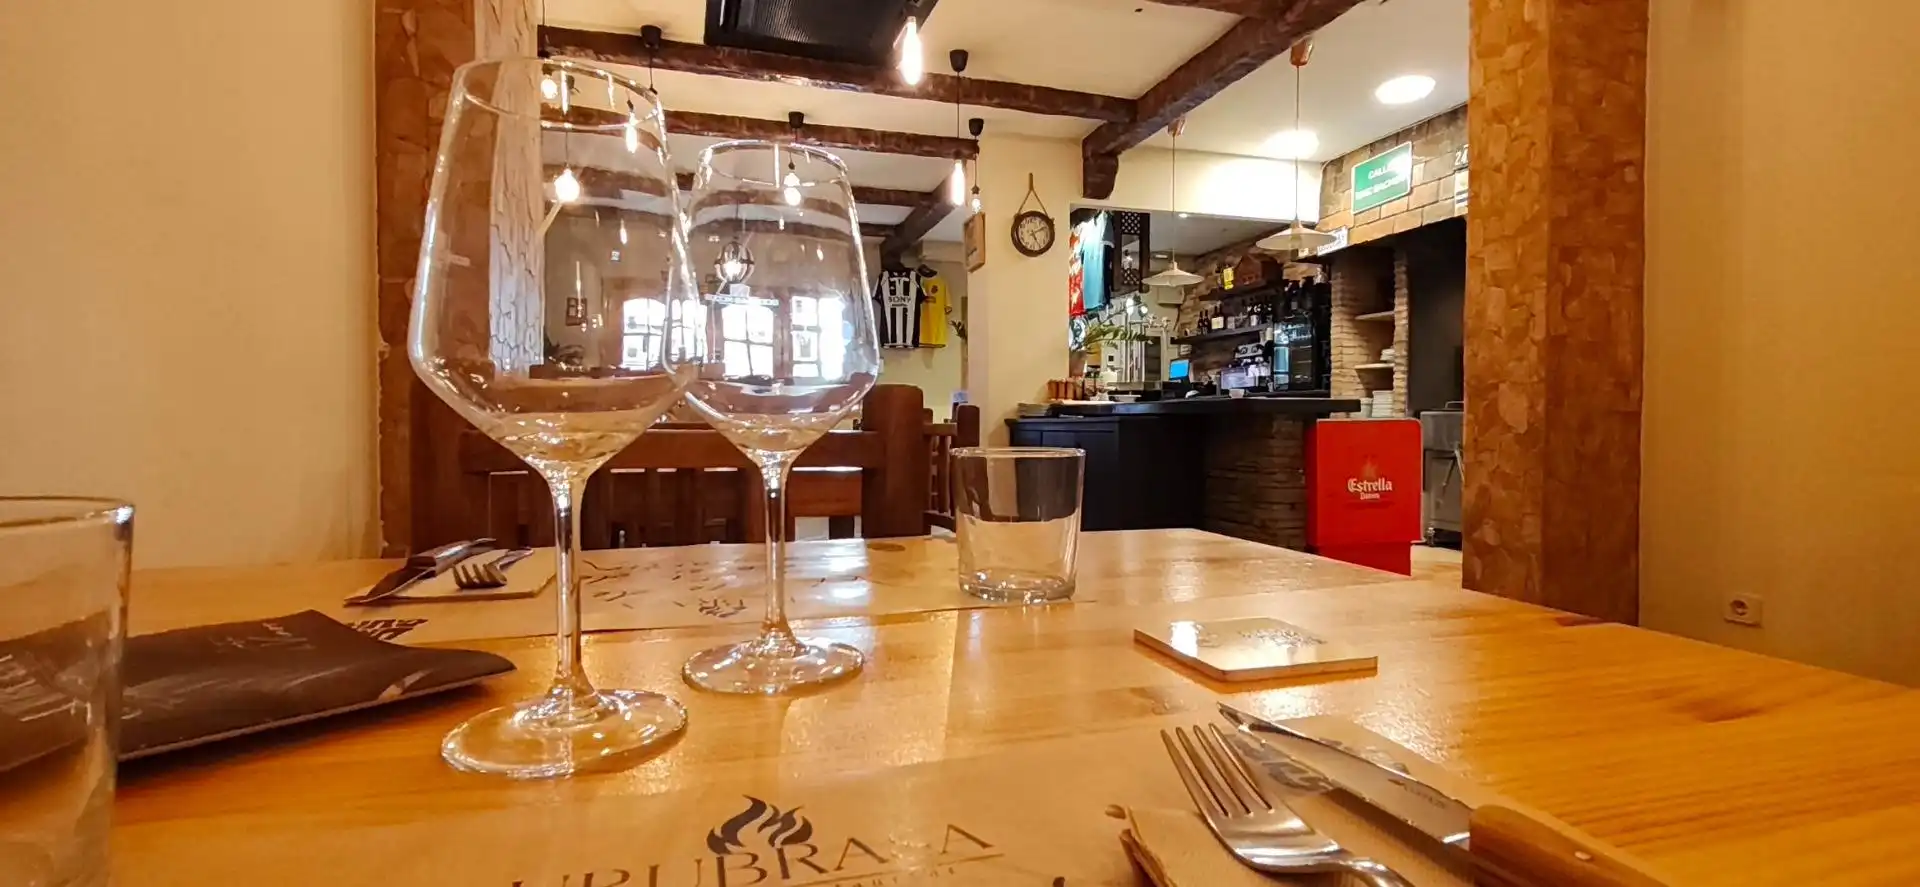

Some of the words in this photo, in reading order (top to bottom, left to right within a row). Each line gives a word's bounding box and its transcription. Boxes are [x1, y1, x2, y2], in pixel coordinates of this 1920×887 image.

[1367, 161, 1394, 180] CALL
[1347, 477, 1393, 492] Estrella
[511, 823, 995, 887] UBRAA
